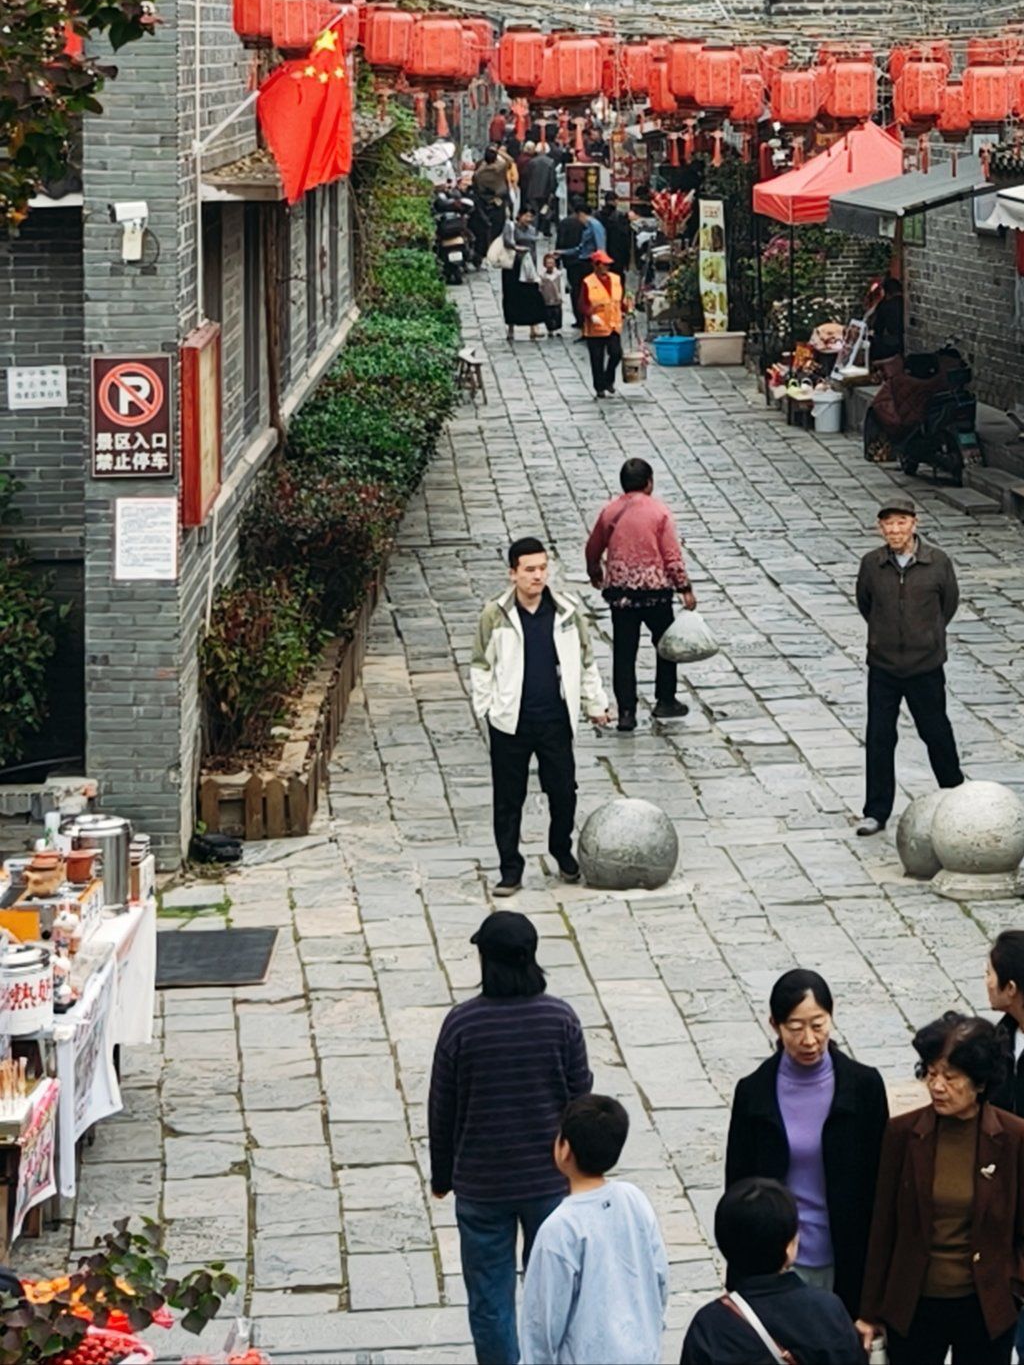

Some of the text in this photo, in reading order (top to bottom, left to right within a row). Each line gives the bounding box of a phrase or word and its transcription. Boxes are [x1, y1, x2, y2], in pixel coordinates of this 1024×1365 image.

[96, 432, 168, 451] 景区入口
[96, 452, 168, 471] 禁止停车
